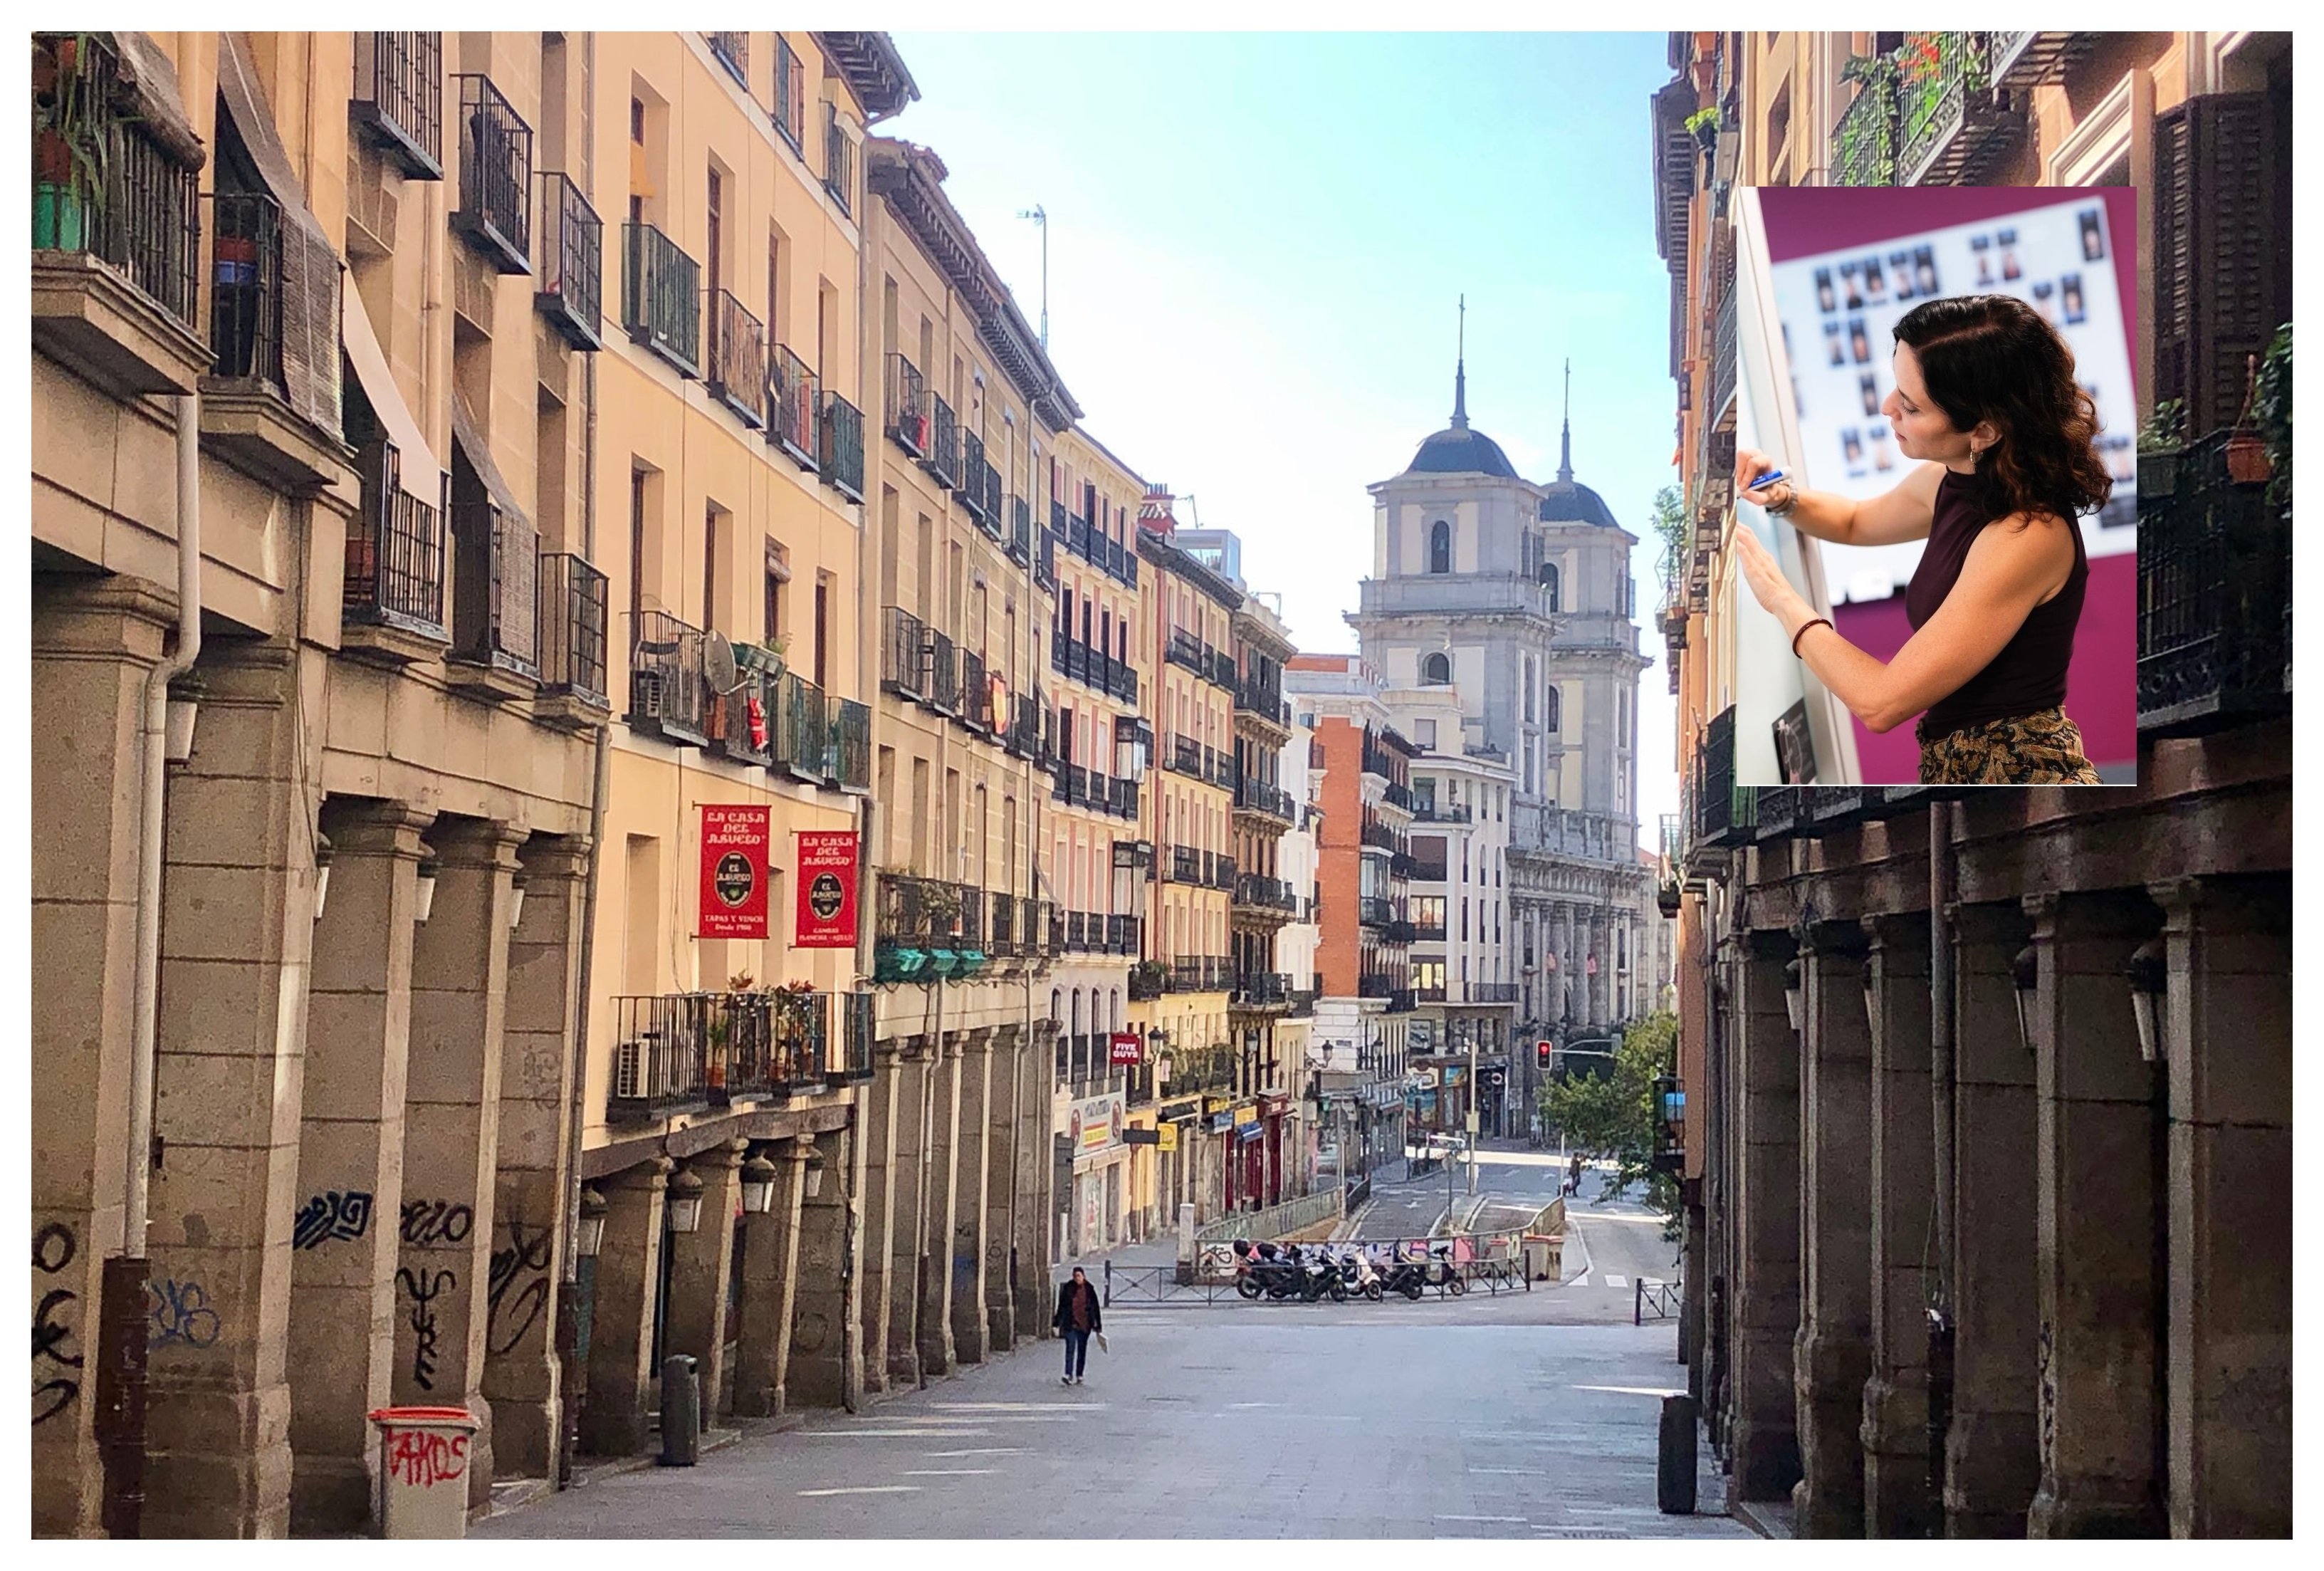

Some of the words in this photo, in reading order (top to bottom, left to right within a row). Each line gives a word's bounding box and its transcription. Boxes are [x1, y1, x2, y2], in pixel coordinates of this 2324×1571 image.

[707, 813, 725, 823] LA
[728, 813, 765, 823] CASA
[723, 823, 749, 833] DEL
[802, 837, 819, 847] LA
[821, 837, 853, 847] CASA
[816, 847, 839, 856] DEL
